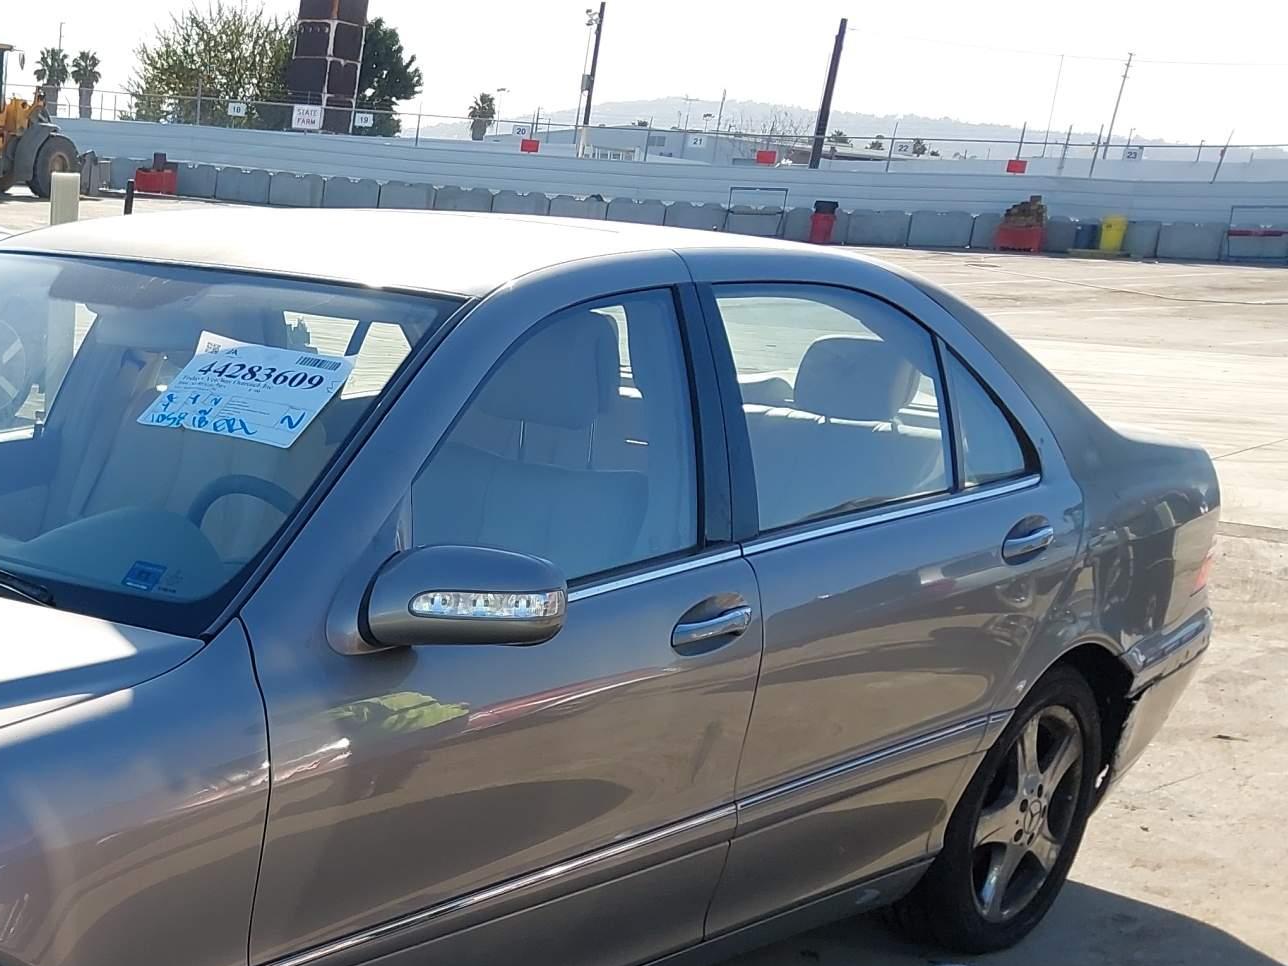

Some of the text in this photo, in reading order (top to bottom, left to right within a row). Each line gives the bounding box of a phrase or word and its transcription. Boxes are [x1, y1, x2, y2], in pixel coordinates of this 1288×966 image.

[297, 108, 317, 116] STATE
[360, 116, 369, 124] 19
[516, 127, 527, 135] 20
[692, 137, 703, 145] 21
[898, 144, 909, 152] 22
[1126, 151, 1138, 159] 23
[198, 361, 325, 390] 44283609
